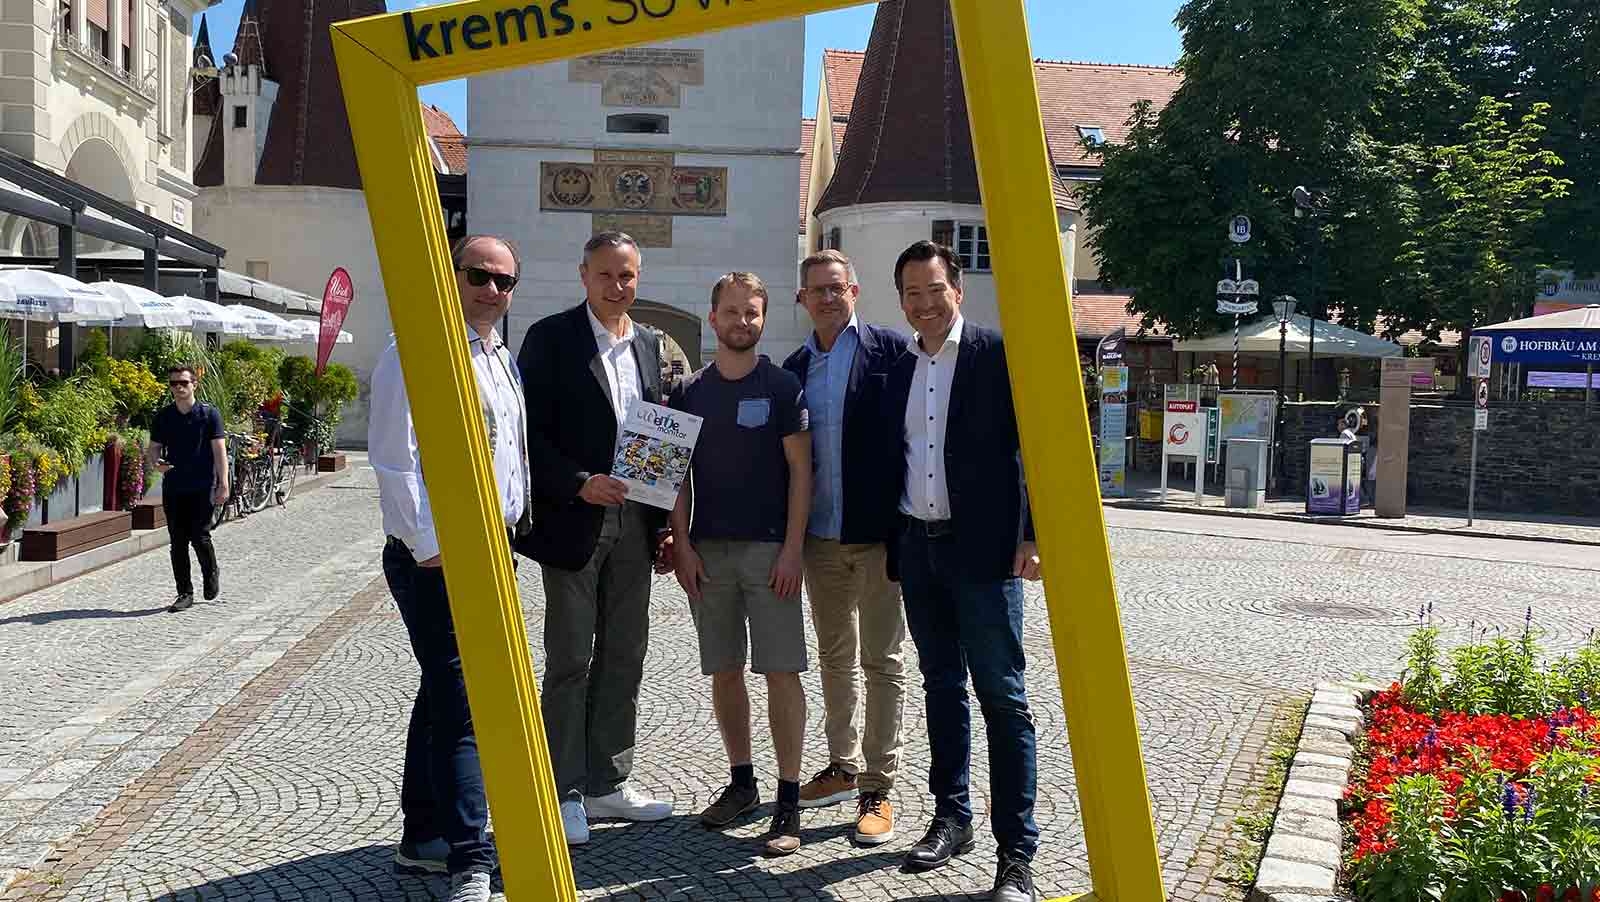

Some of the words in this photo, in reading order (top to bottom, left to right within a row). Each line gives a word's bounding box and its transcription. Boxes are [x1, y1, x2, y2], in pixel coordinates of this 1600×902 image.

[402, 0, 592, 61] krems.
[1520, 339, 1575, 351] HOFBRÄU
[1577, 341, 1597, 351] AM
[656, 426, 687, 440] monitor
